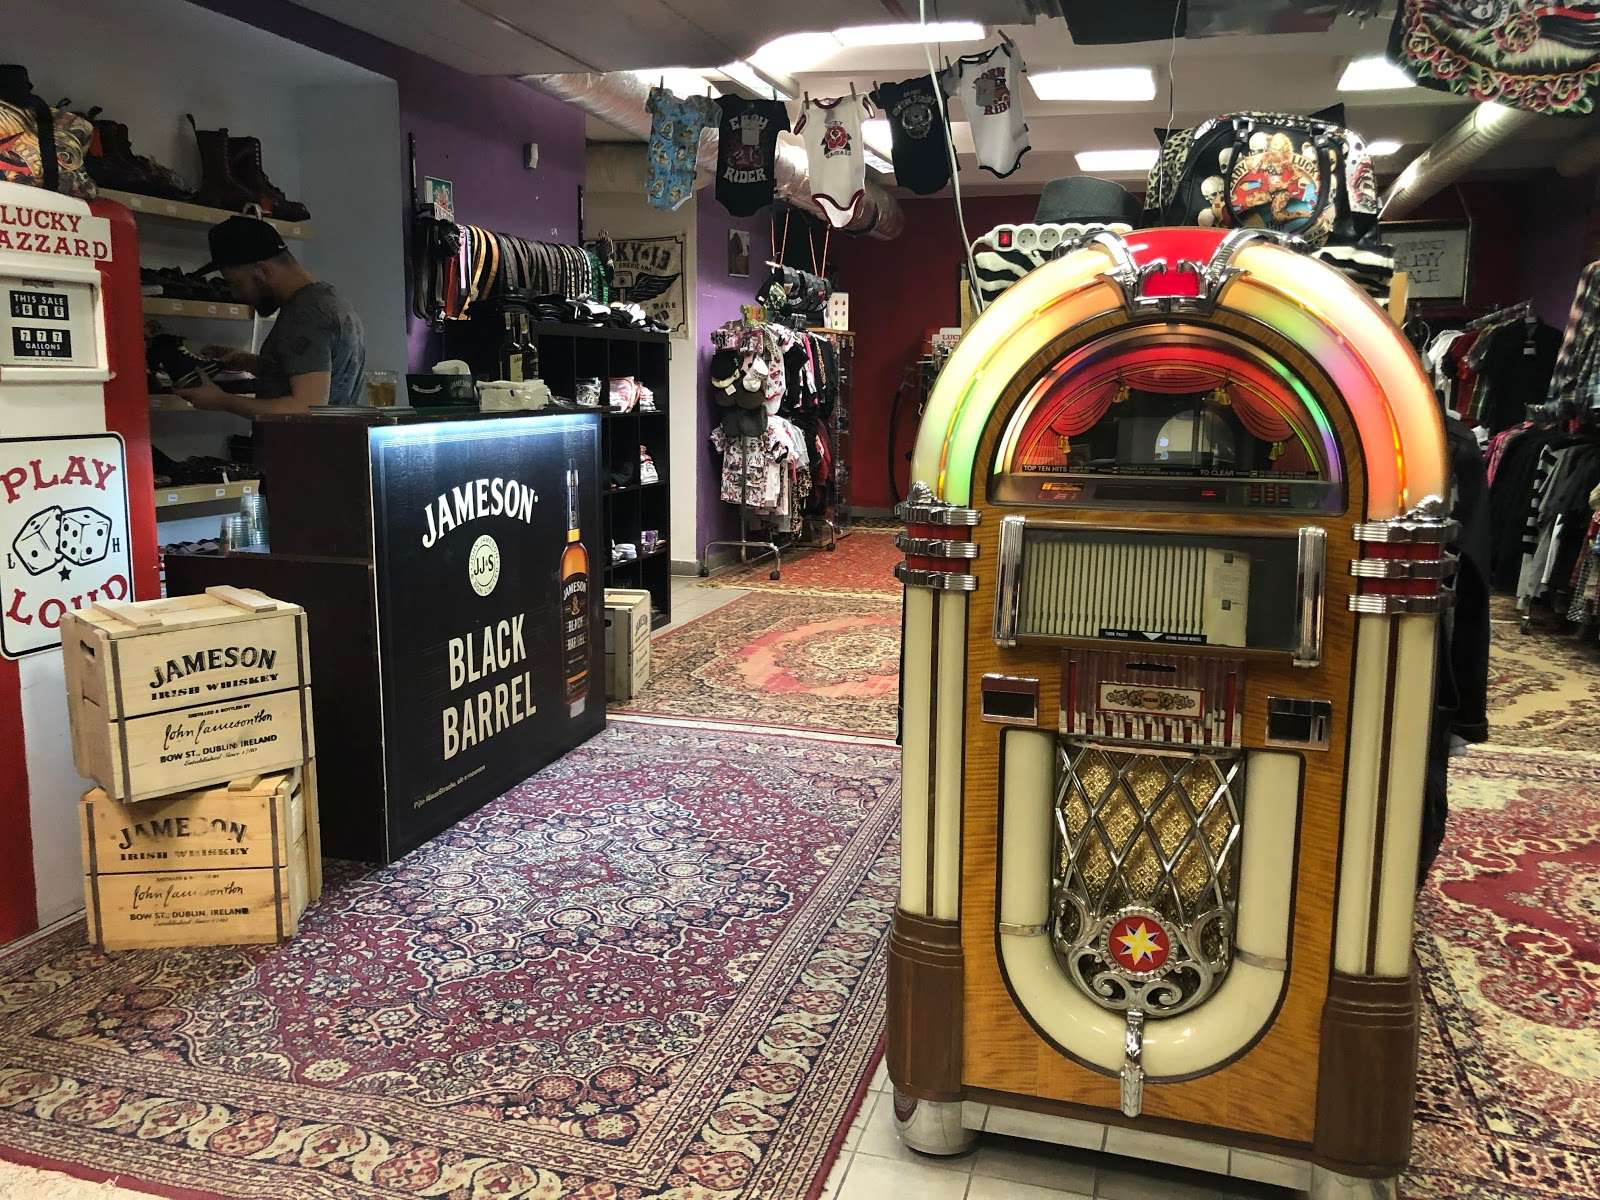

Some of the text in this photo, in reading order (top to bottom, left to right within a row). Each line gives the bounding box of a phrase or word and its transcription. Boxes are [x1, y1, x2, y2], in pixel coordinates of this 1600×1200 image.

[0, 205, 82, 234] LUCKY
[13, 294, 65, 306] THIS SALE
[25, 343, 61, 351] GALLONS
[0, 455, 116, 503] PLAY
[1038, 465, 1051, 473] TEN
[112, 537, 120, 553] H
[563, 580, 587, 601] JAMESON
[449, 613, 527, 691] BLACK
[149, 647, 277, 689] JAMESON
[151, 673, 279, 701] IRISH WHISKEY
[443, 671, 537, 761] BARREL
[160, 752, 183, 763] BOW
[240, 734, 278, 748] IRELAND
[163, 723, 194, 751] John
[120, 847, 250, 861] IRISH WHISKEY
[129, 912, 152, 921] BOW
